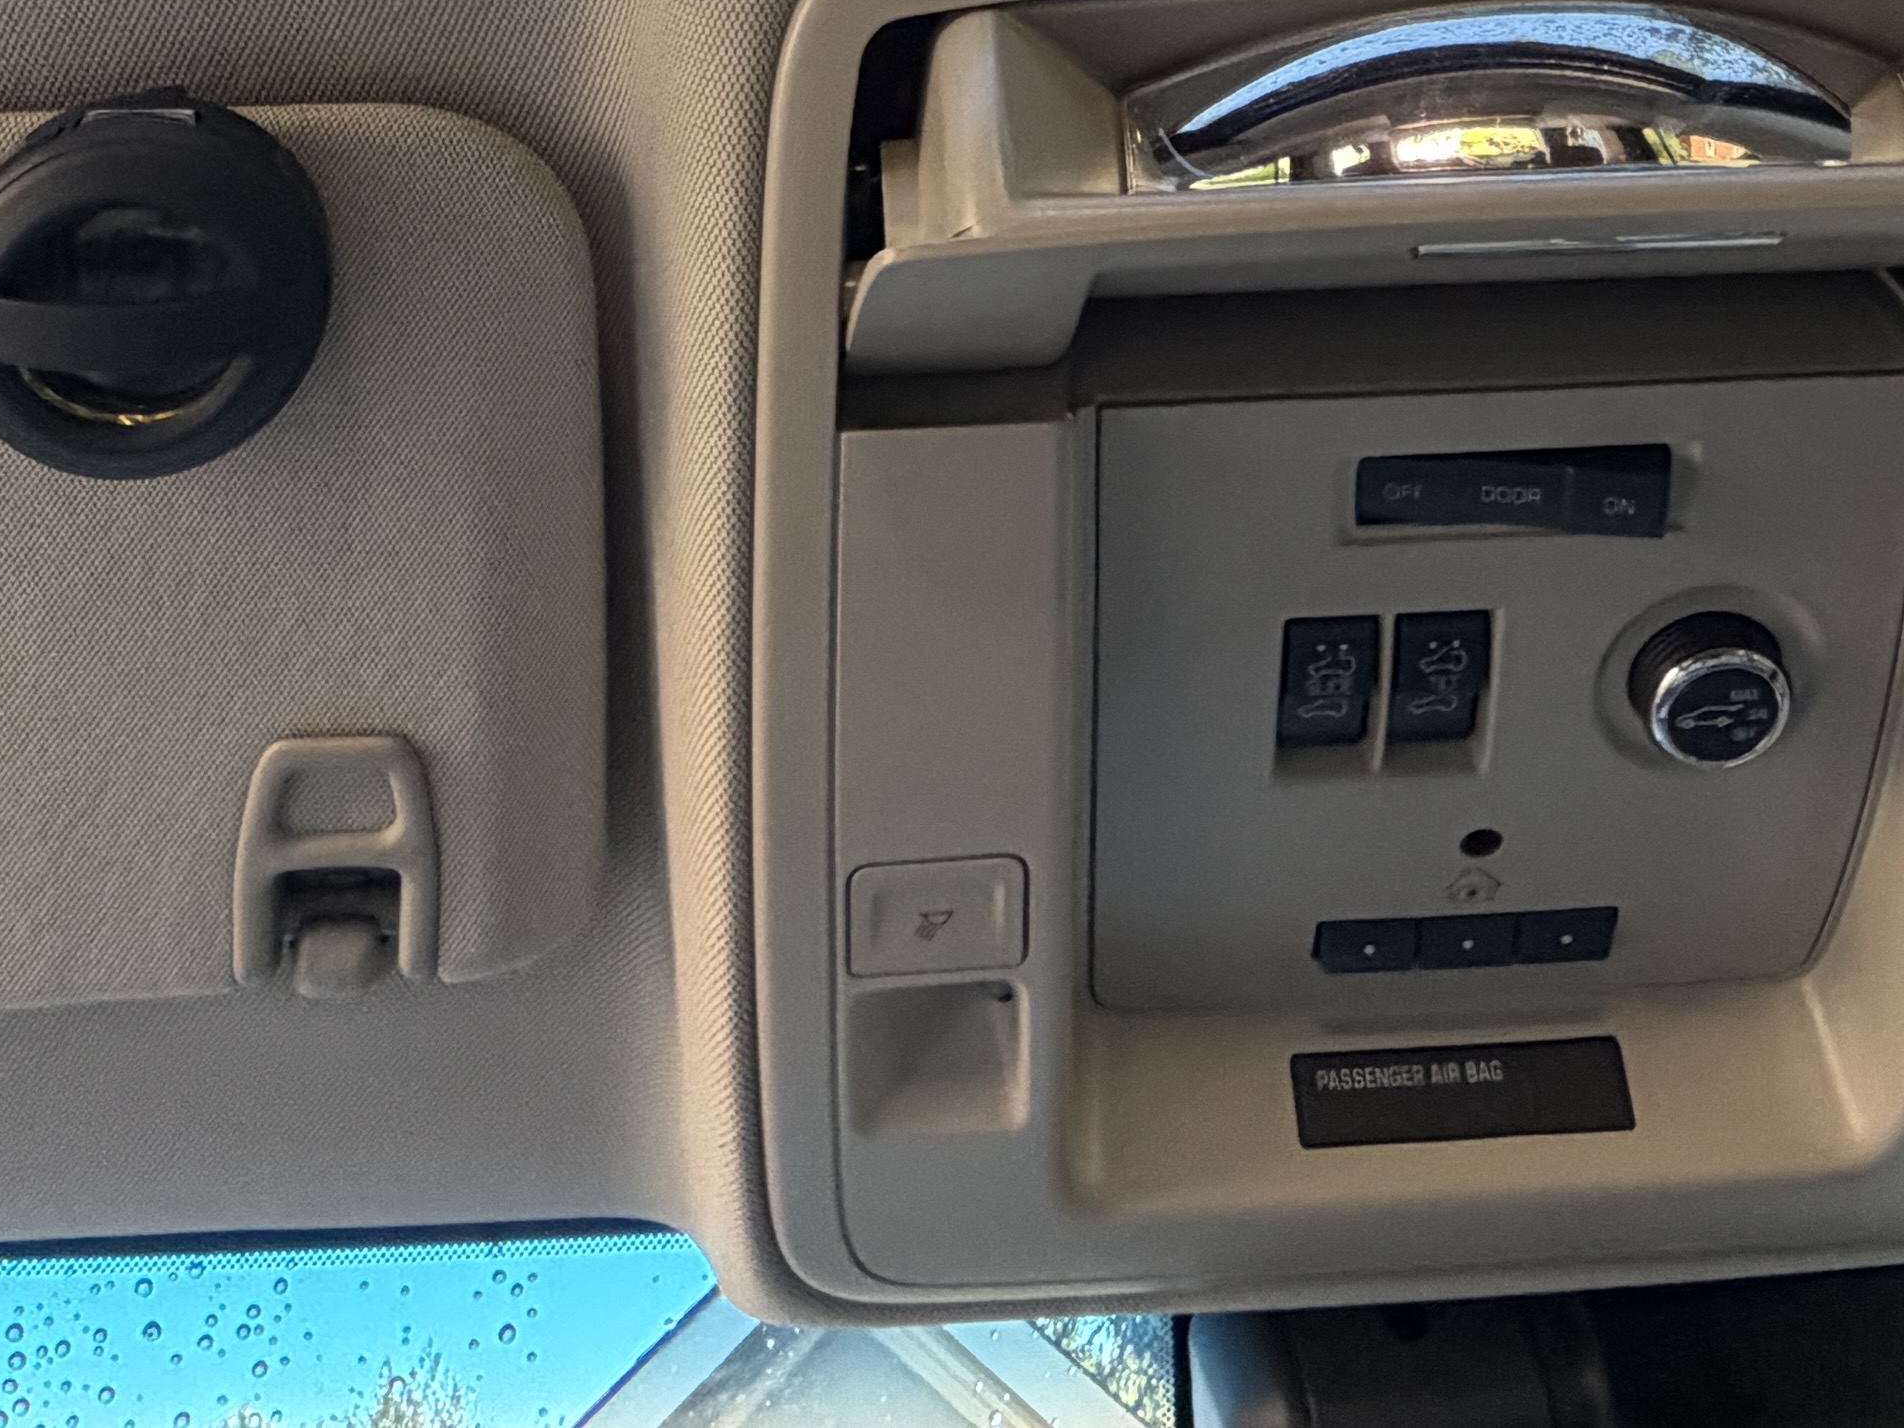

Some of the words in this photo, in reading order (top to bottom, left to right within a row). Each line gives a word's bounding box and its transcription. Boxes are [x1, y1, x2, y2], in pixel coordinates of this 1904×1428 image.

[1315, 1064, 1426, 1091] PASSENGER
[1430, 1061, 1462, 1084] AIR
[1464, 1059, 1505, 1084] BAG
